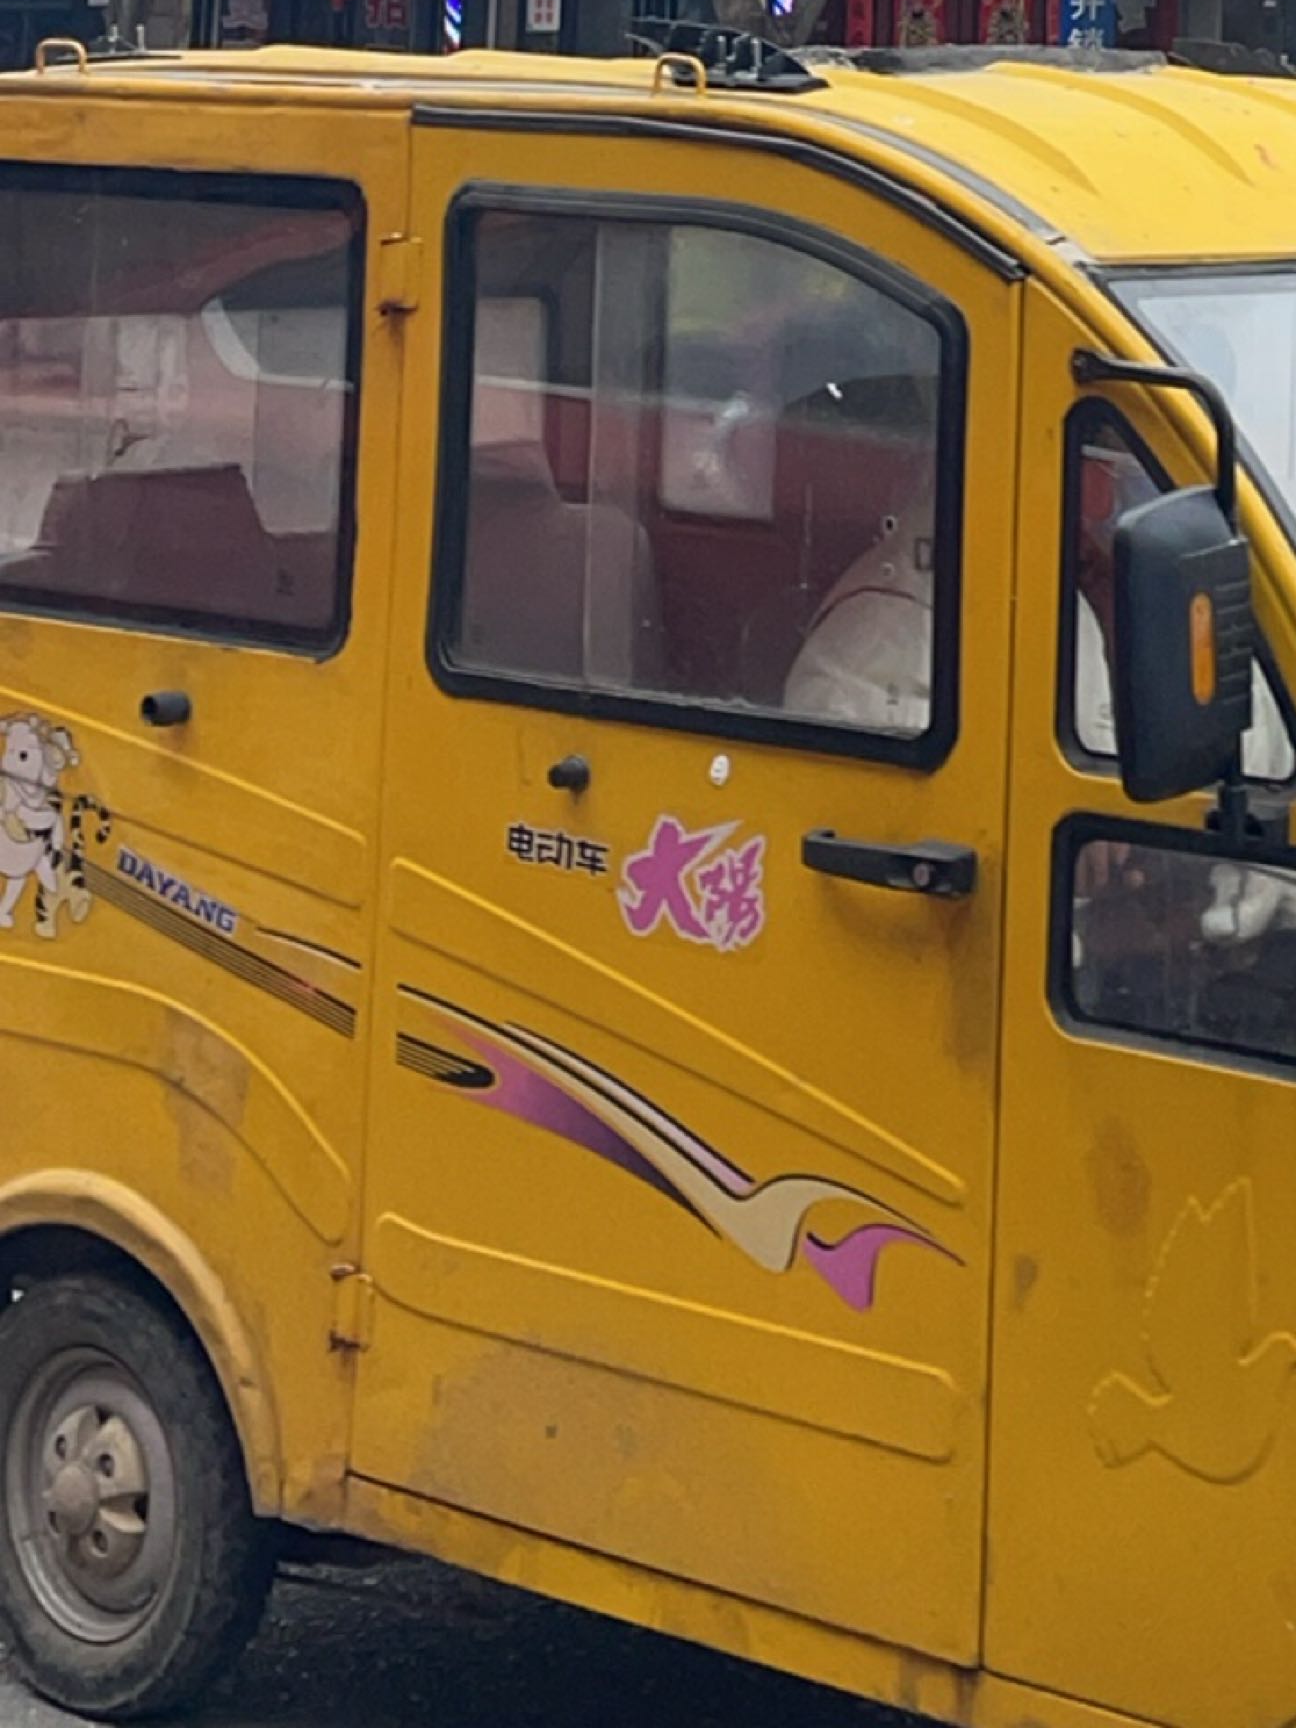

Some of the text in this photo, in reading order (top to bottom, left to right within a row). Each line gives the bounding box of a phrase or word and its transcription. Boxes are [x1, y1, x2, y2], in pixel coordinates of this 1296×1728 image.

[508, 825, 610, 874] 电动车
[117, 846, 237, 935] DAYANG
